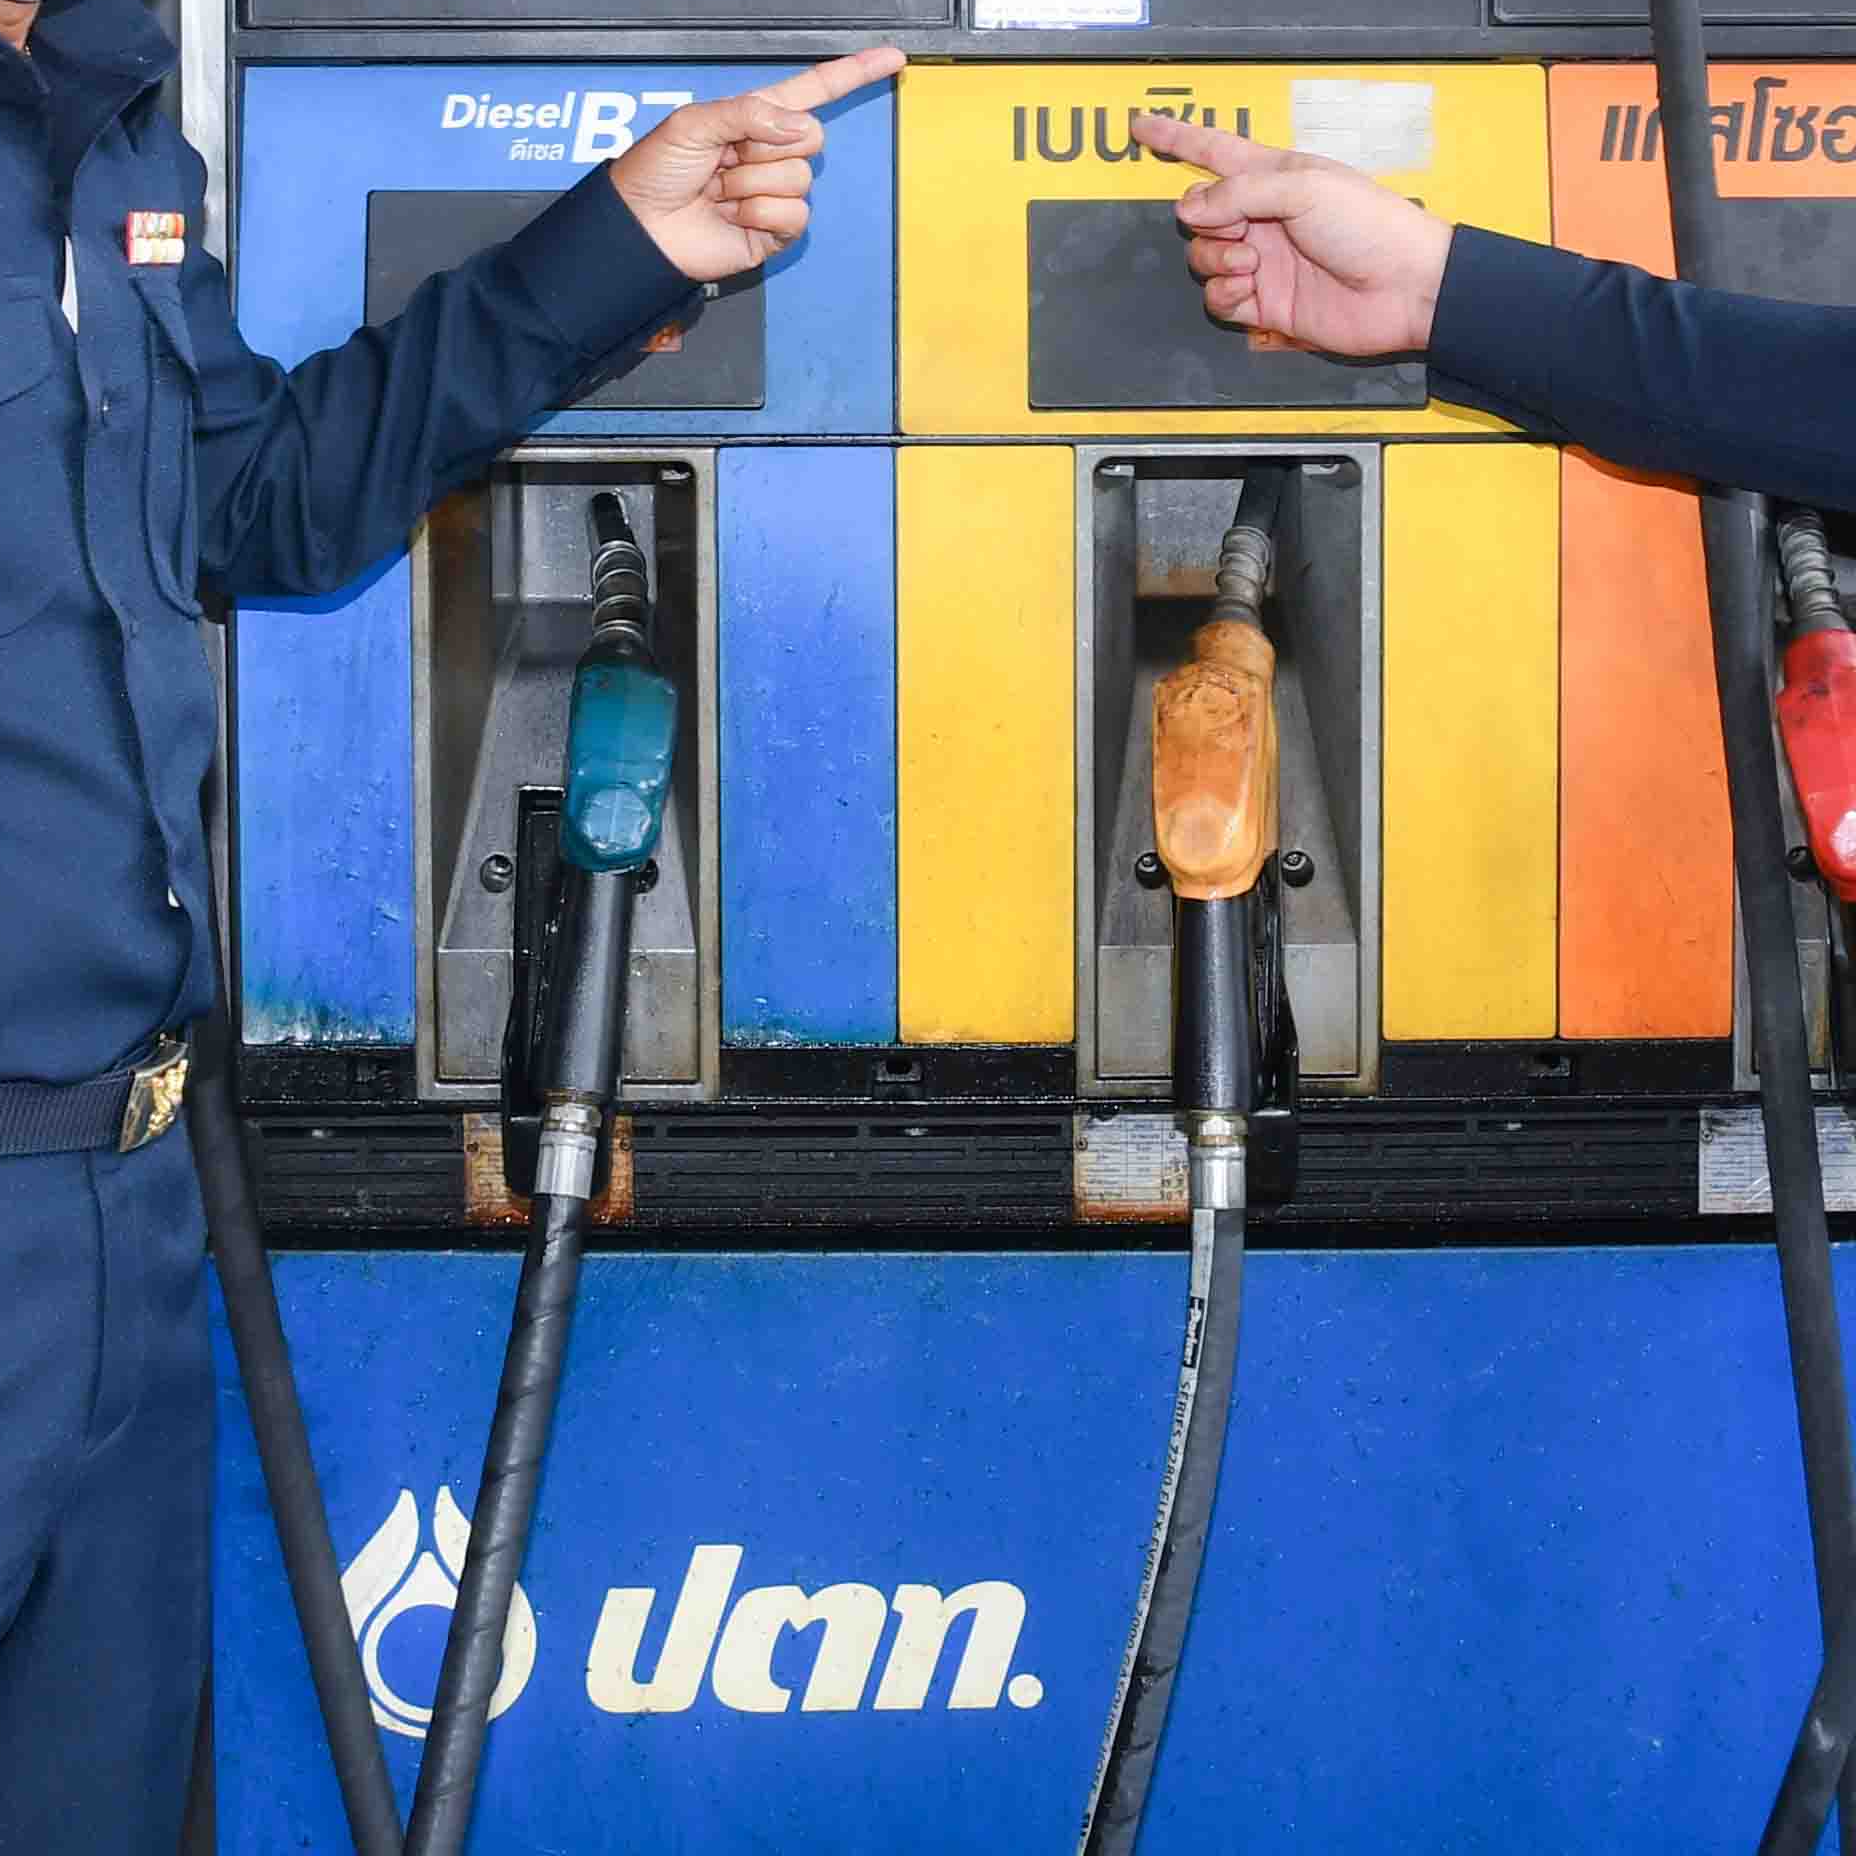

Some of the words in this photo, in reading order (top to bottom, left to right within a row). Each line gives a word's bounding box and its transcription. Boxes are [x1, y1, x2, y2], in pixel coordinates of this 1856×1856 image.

[441, 92, 574, 129] Diesel
[508, 137, 565, 161] ดีเซล
[586, 1544, 1044, 1714] ปตท.
